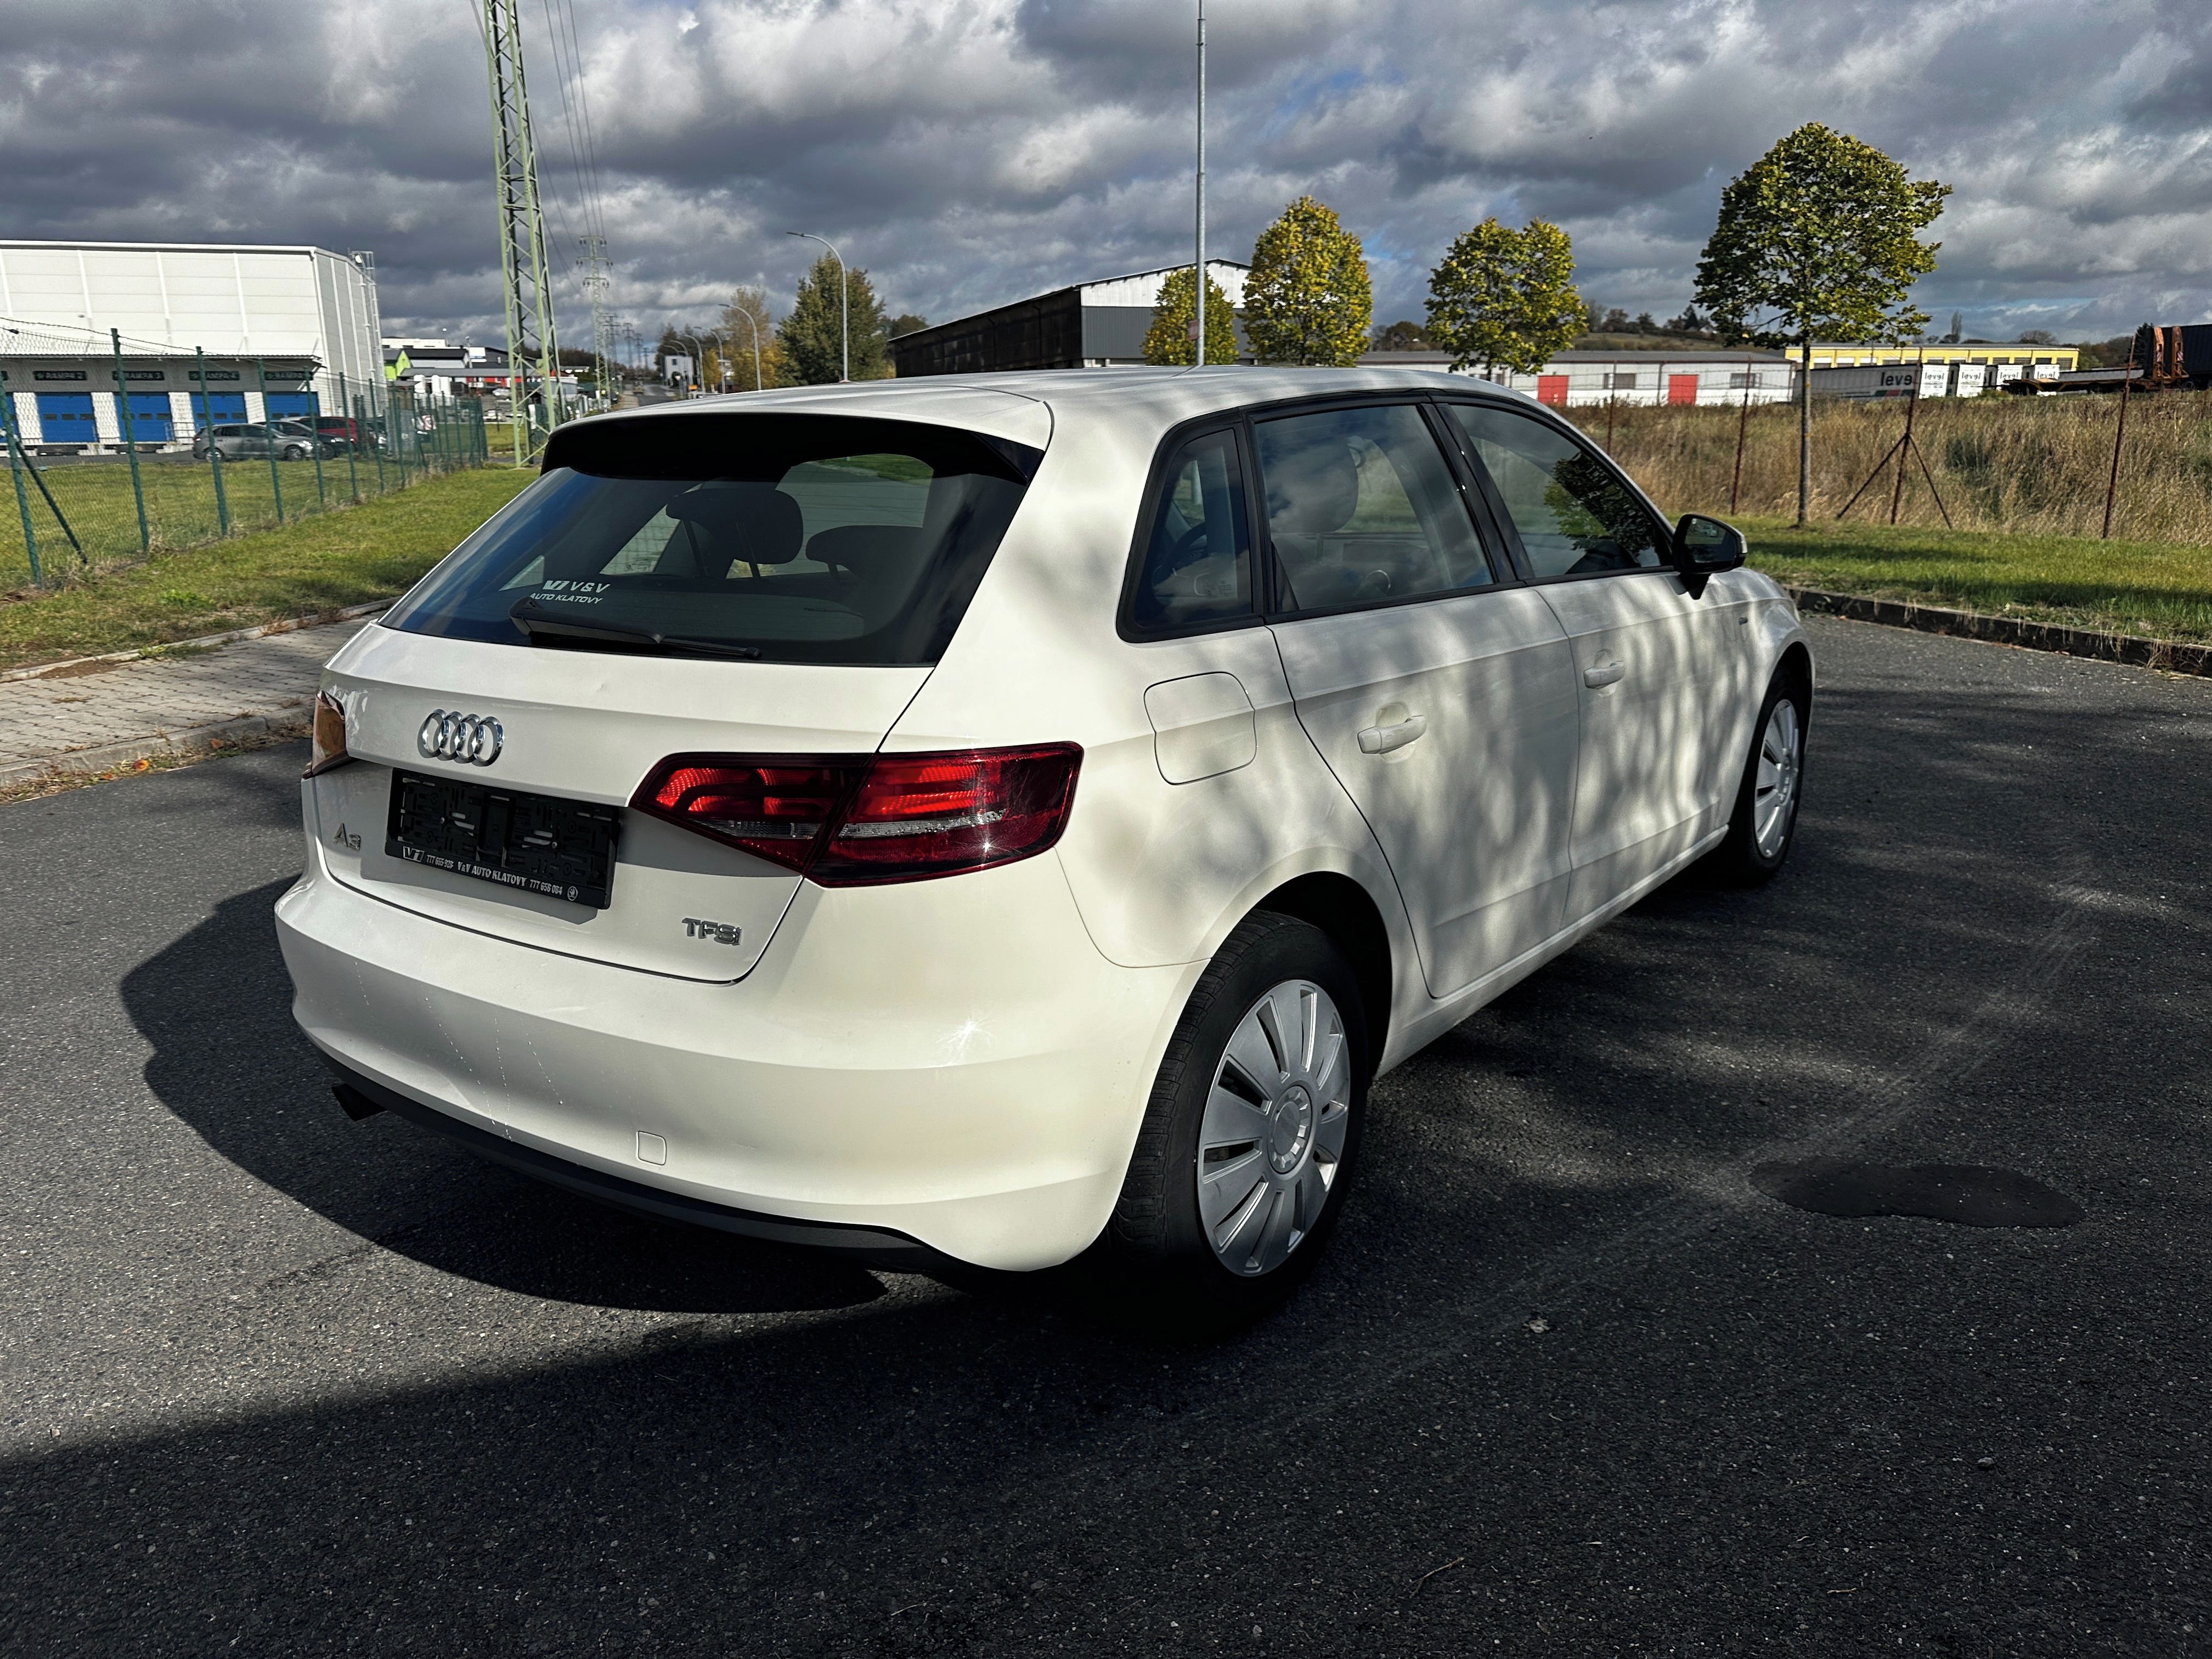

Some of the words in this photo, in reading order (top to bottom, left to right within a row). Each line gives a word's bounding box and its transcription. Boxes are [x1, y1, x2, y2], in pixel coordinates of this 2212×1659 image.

[1880, 372, 1914, 386] leve
[1925, 372, 1945, 380] level
[1961, 371, 1981, 380] level
[570, 582, 611, 593] V&V
[555, 594, 603, 604] KLATOVY
[334, 823, 361, 851] A3
[458, 861, 471, 873] V&V
[471, 865, 492, 878] AUTO
[492, 870, 527, 887] KLATOVY
[529, 879, 541, 890] 777
